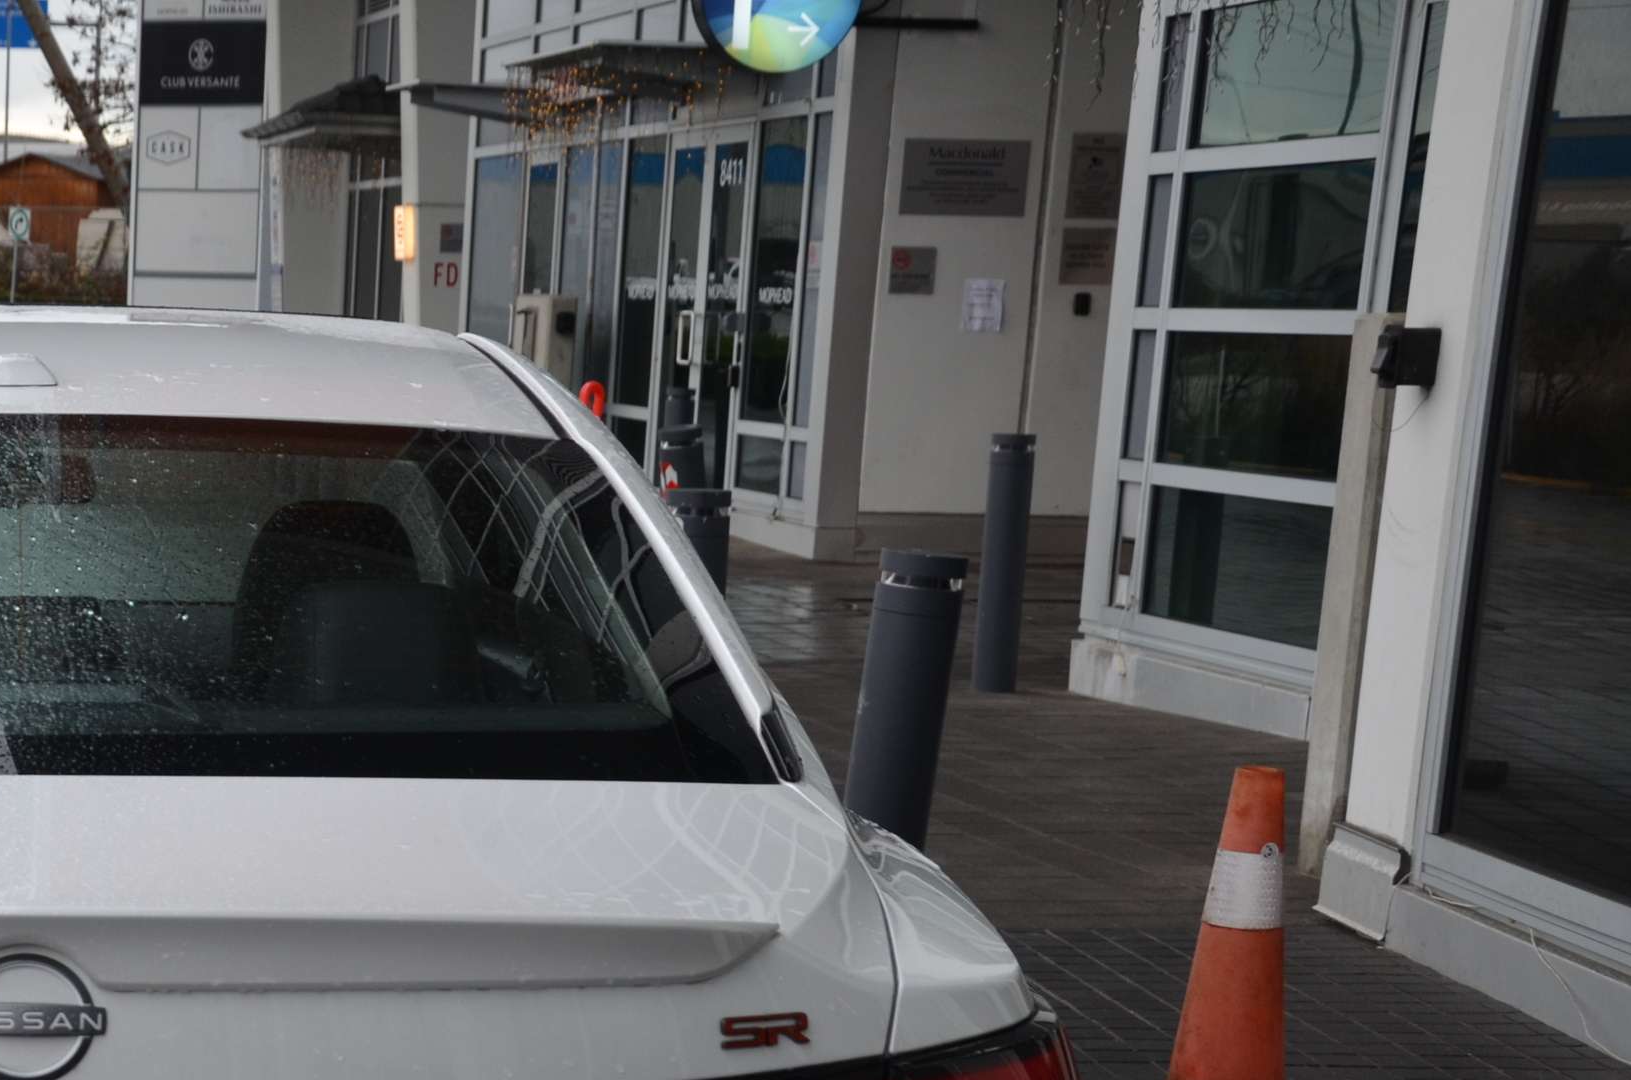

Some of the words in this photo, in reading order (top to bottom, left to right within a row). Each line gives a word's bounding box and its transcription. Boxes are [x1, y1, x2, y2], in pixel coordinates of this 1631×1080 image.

[161, 77, 186, 88] CLUB
[720, 158, 744, 187] 8411
[433, 262, 458, 288] FD
[720, 1011, 811, 1050] SR
